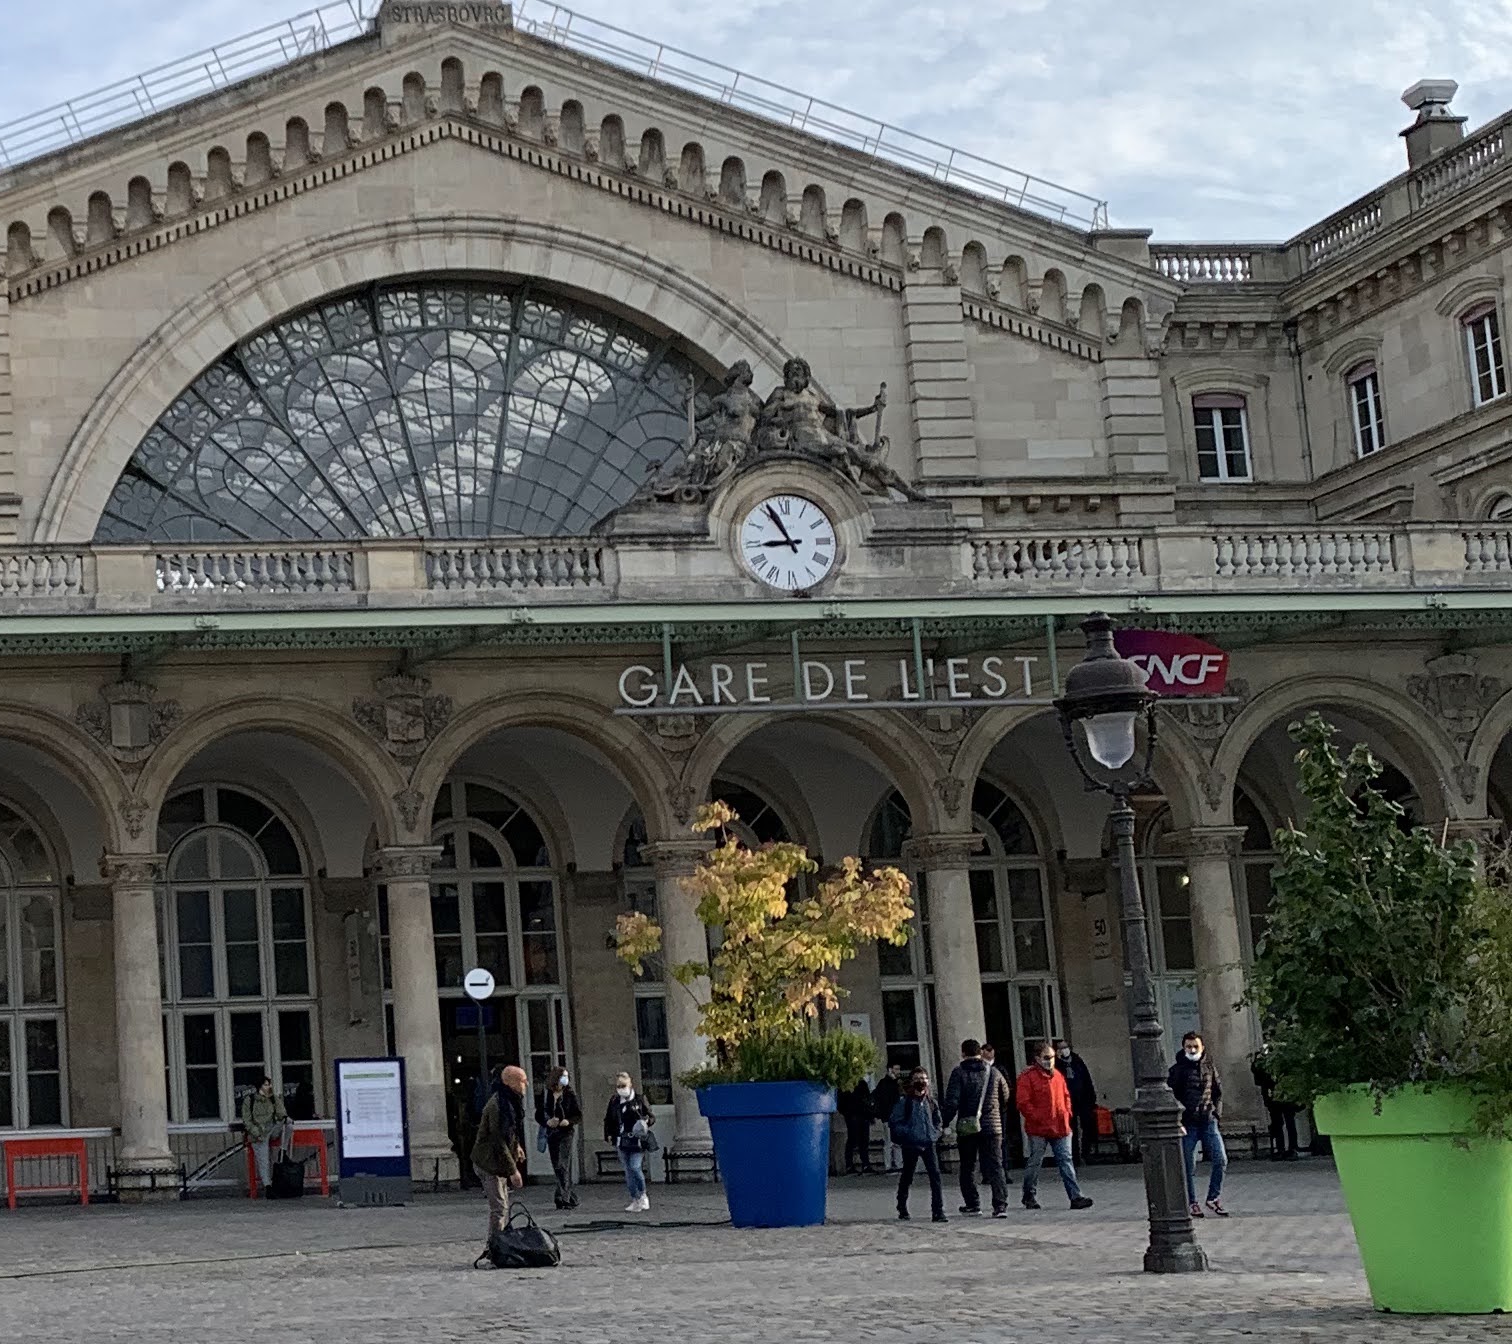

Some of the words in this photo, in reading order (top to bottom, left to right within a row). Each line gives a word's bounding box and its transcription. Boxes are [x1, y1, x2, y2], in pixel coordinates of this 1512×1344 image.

[618, 663, 771, 706] GARE
[802, 661, 869, 701] DE
[900, 657, 1038, 699] L'EST
